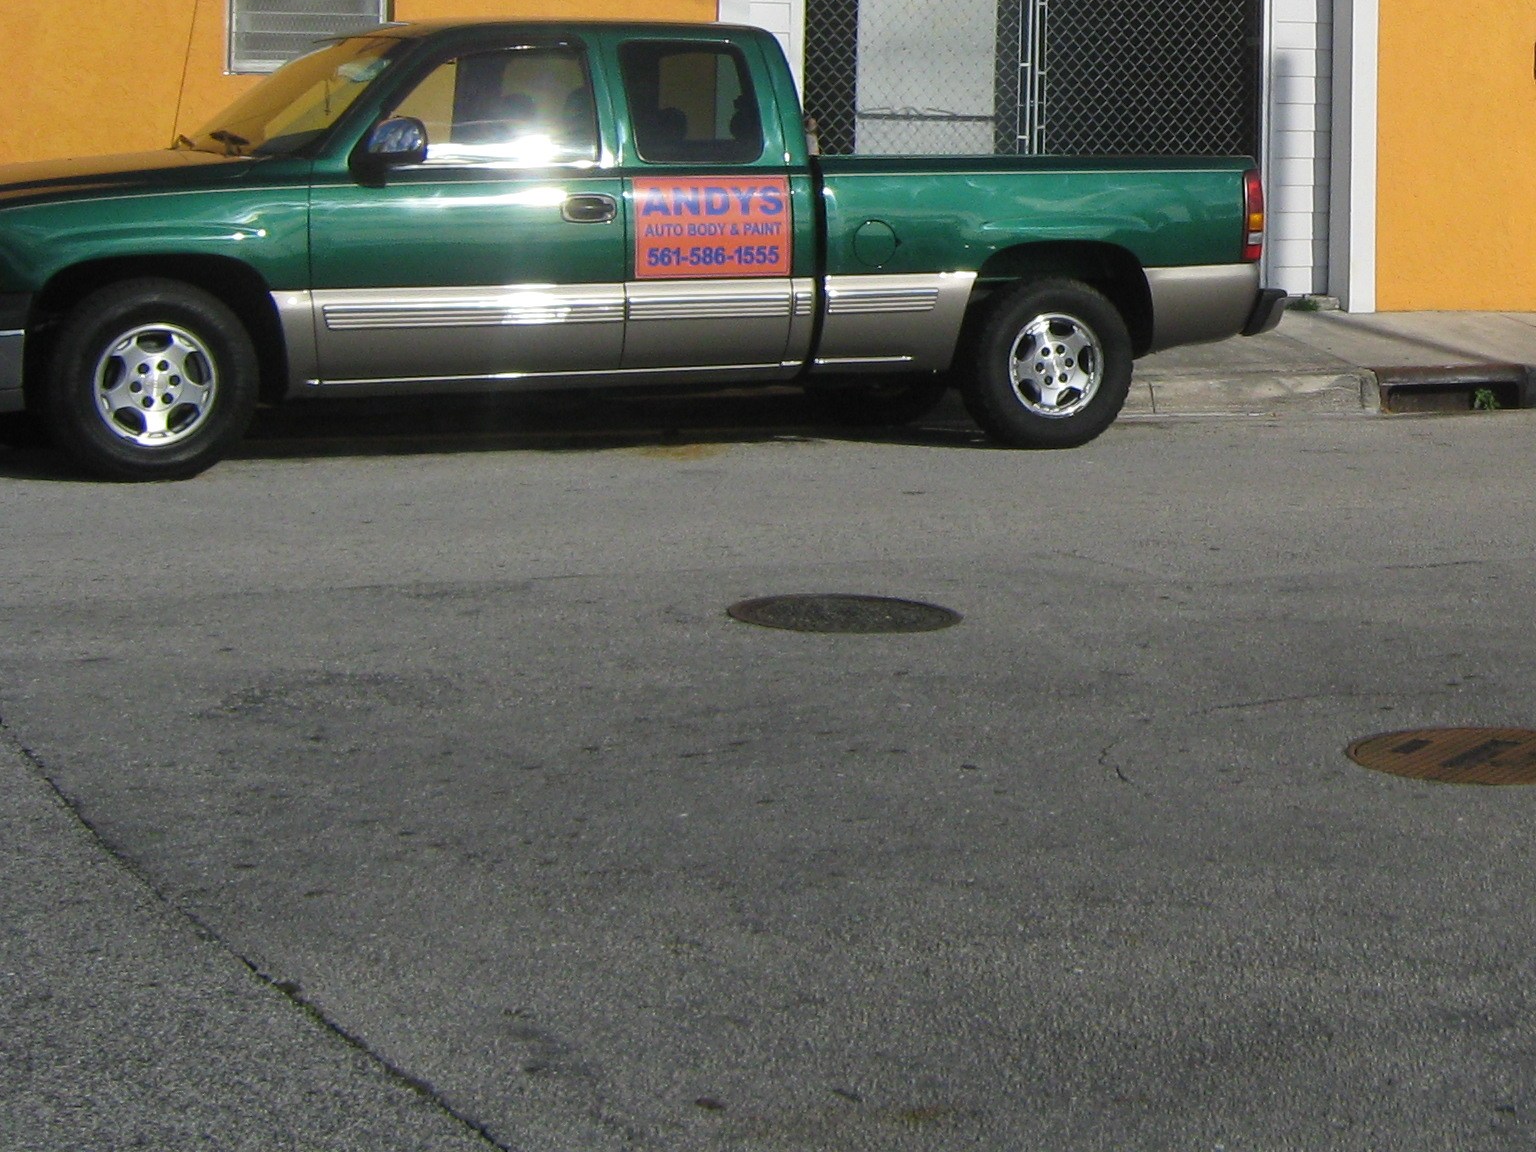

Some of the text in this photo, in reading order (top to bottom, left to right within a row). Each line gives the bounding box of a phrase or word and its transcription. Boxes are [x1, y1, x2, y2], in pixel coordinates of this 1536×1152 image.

[642, 185, 784, 217] ANDYS
[645, 222, 782, 237] AUTO BODY & PAINT
[647, 245, 780, 267] 561-586-1555
